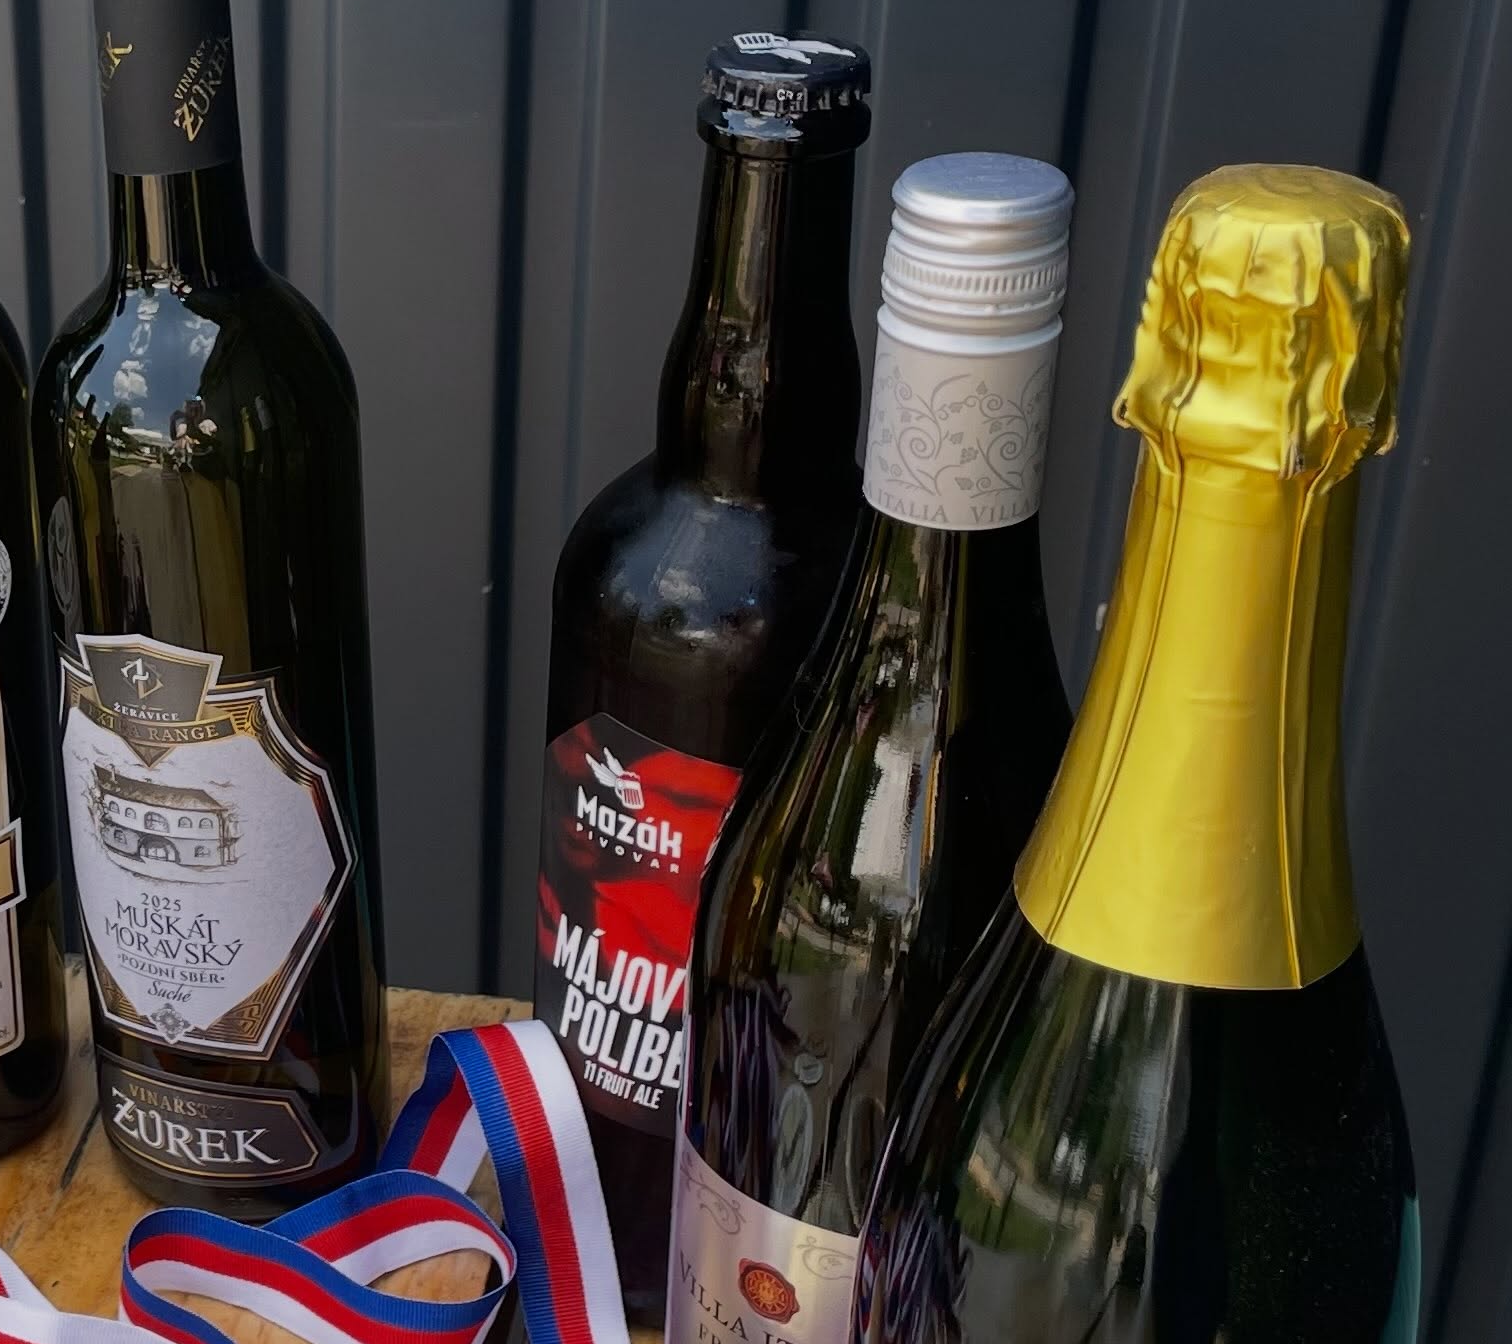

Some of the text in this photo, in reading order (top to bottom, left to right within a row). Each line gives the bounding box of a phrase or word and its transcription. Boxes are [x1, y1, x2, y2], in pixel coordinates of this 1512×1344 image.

[878, 488, 949, 524] ITALIA
[970, 498, 1032, 524] VILLA
[148, 725, 219, 742] RANGE
[577, 785, 683, 859] Mazák
[576, 822, 680, 875] PIVOVAR
[116, 899, 220, 944] MUŠKÁT
[141, 892, 182, 912] 2025
[105, 916, 244, 966] MORAVSKÝ
[121, 953, 176, 980] POZDNÍ
[148, 980, 193, 1003] Suché
[595, 1066, 635, 1099] FRUIT
[633, 1084, 664, 1110] ALE
[111, 1087, 281, 1167] ŽUREK
[678, 1249, 749, 1343] VILLA
